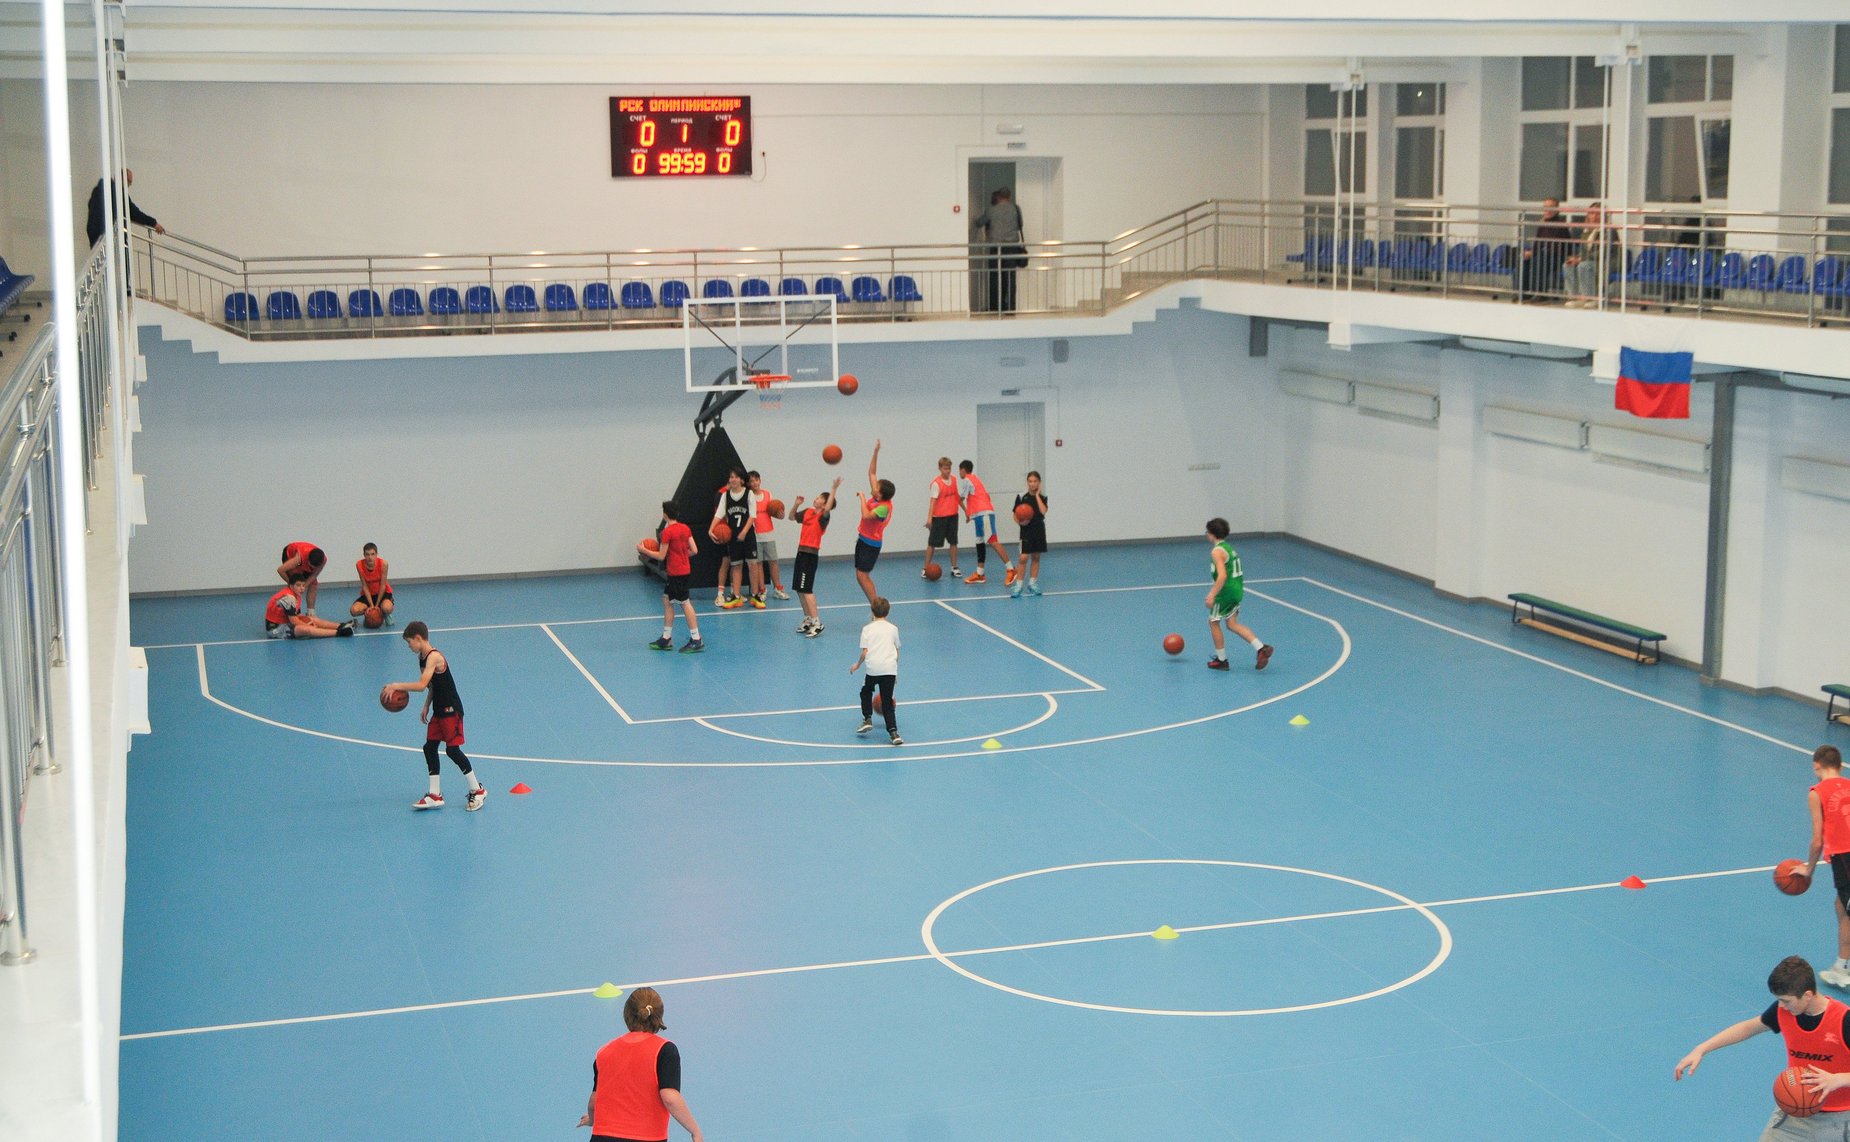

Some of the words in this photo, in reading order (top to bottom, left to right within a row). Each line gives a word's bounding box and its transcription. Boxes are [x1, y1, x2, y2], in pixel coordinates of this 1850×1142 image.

[619, 99, 644, 112] РСК
[640, 120, 655, 147] 0
[682, 124, 688, 143] 1
[725, 119, 741, 146] 0
[633, 154, 646, 174] 0
[659, 153, 706, 174] 99:59
[718, 153, 731, 173] 0
[734, 515, 742, 527] 7
[1232, 558, 1243, 578] 11
